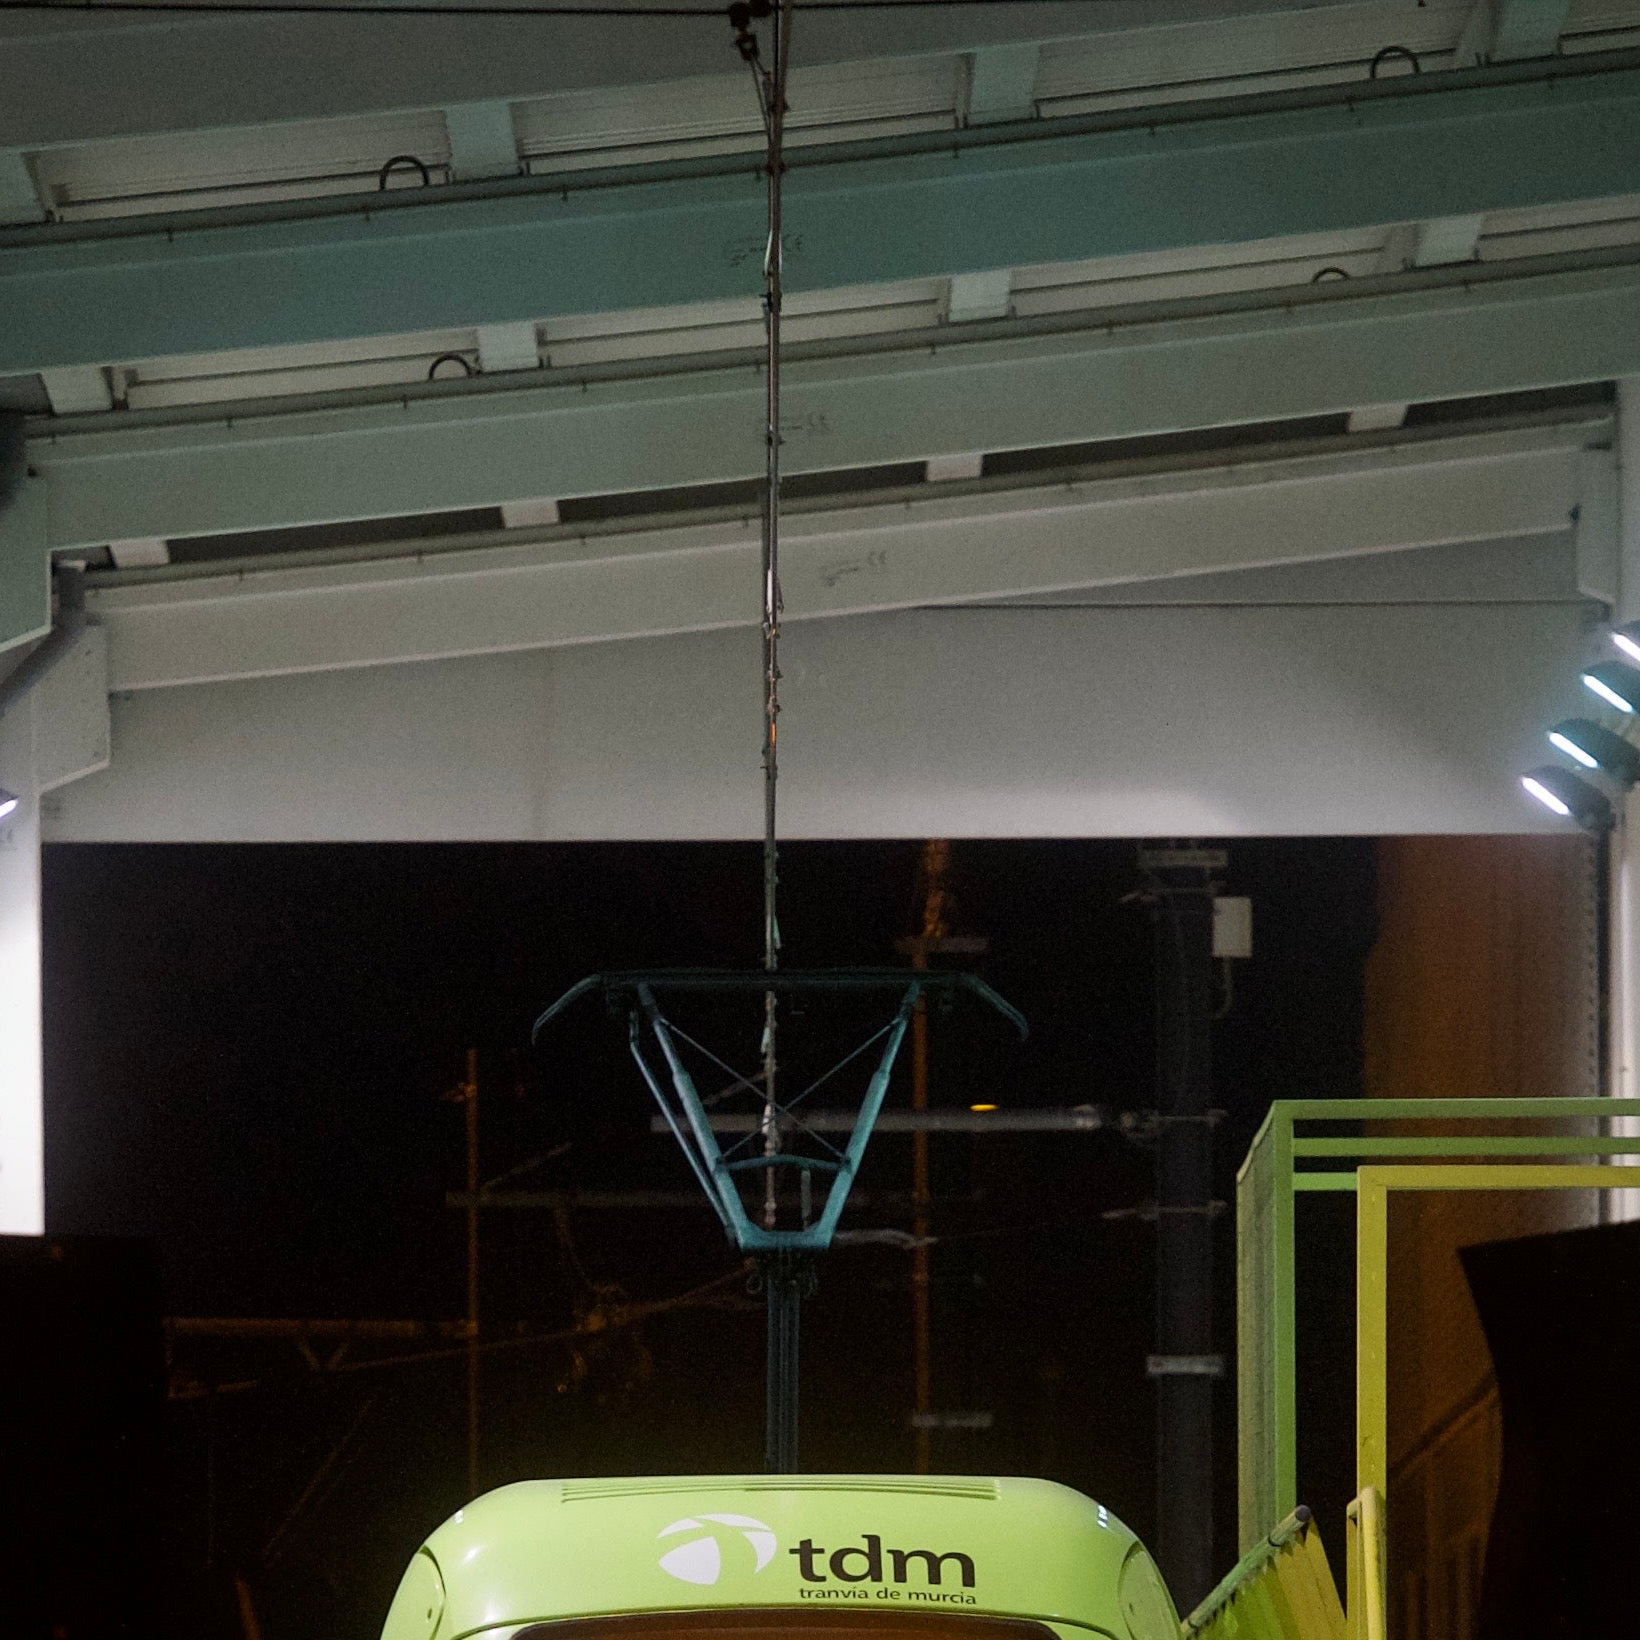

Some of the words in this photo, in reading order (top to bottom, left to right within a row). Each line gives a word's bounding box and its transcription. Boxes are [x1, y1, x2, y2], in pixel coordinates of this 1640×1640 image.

[789, 1534, 976, 1588] tdm
[875, 1587, 901, 1600] de
[907, 1590, 977, 1605] murcia
